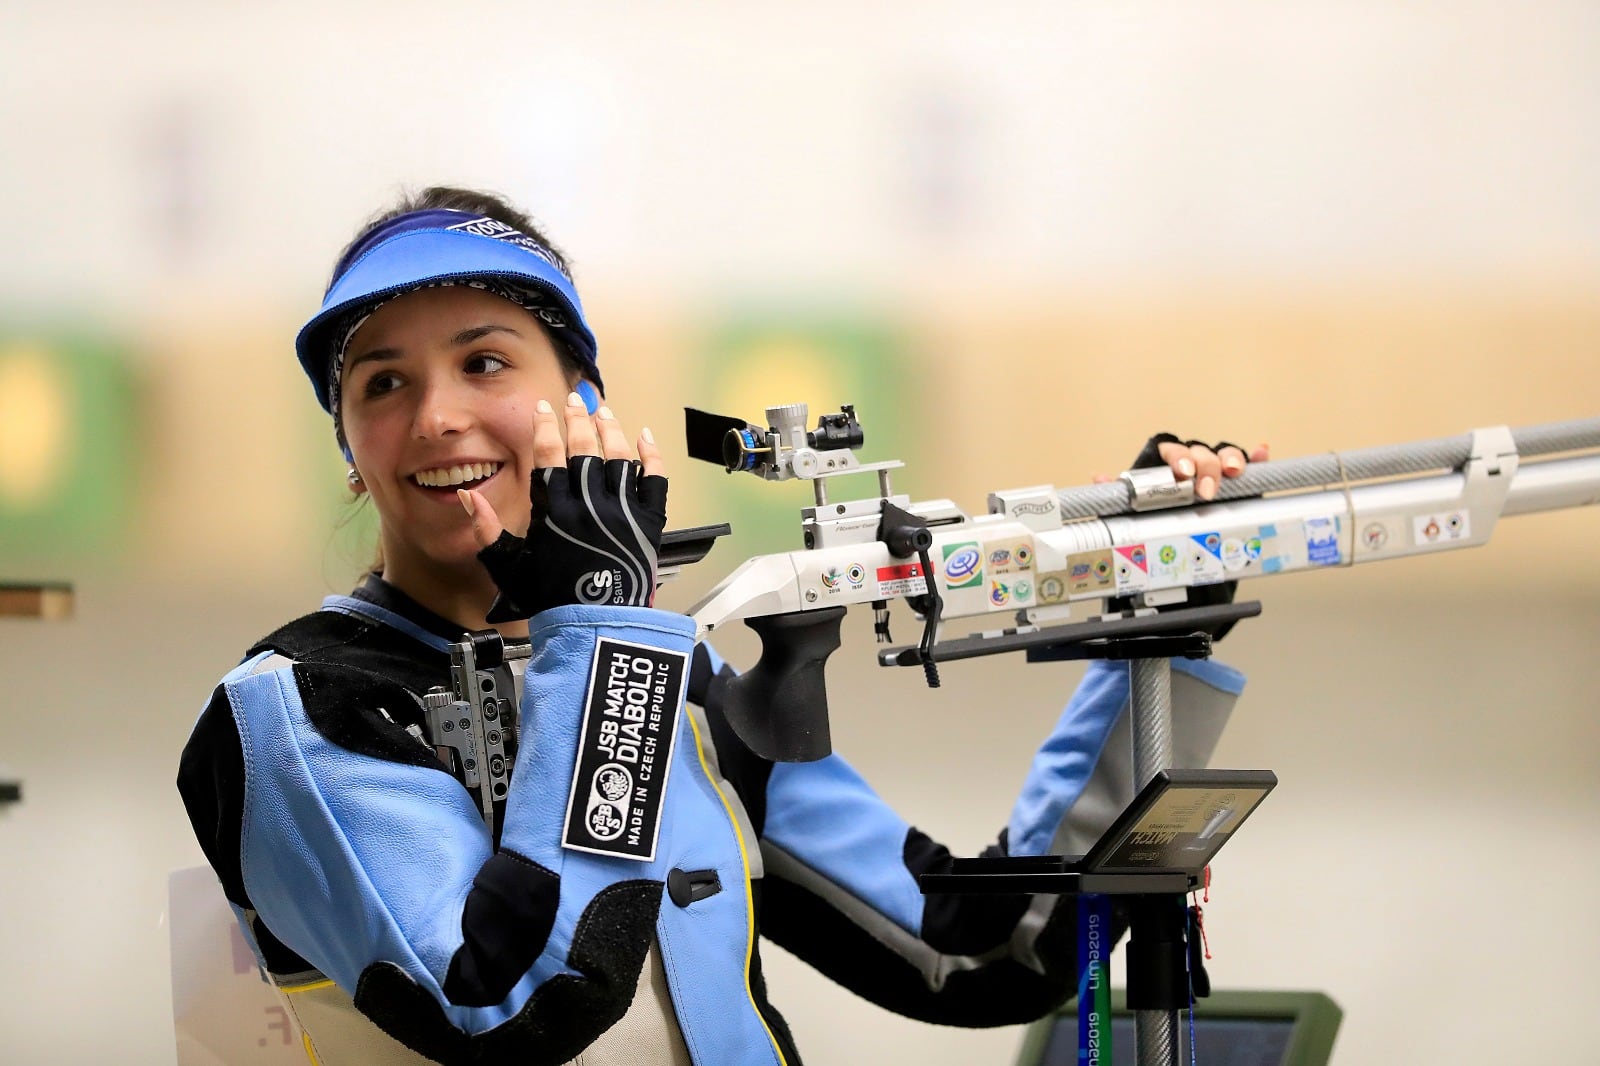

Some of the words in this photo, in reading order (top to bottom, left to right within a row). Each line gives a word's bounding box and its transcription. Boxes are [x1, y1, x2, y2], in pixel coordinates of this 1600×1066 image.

[613, 568, 624, 604] Sauer
[603, 652, 632, 718] MATCH
[649, 662, 670, 732] REPUBLIC
[616, 657, 654, 764] DIABOLO
[597, 720, 618, 760] JSB
[639, 736, 657, 781] CZECH
[635, 786, 648, 803] IN
[628, 807, 644, 846] MADE
